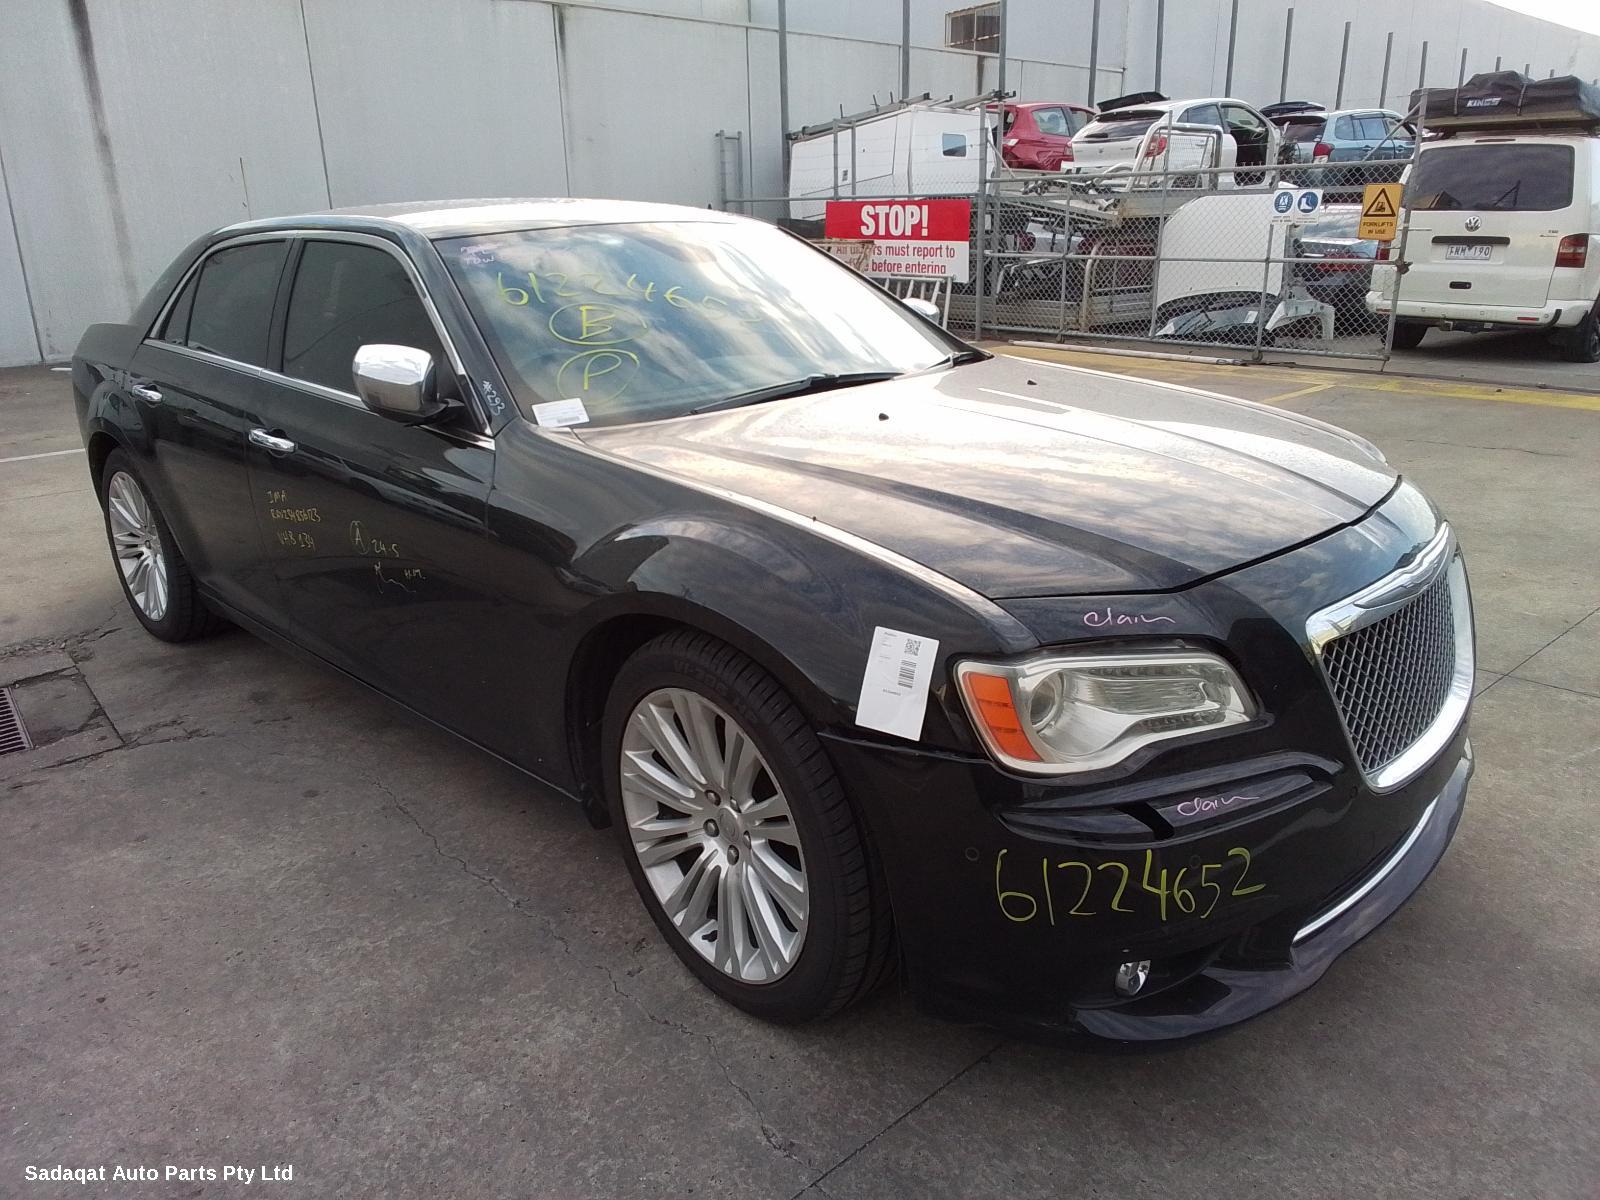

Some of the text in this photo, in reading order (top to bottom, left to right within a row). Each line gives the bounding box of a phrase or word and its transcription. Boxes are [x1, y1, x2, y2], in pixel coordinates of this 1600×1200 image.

[1466, 97, 1501, 107] KINGS
[860, 204, 929, 237] STOP!
[885, 244, 911, 257] must
[912, 244, 943, 261] report
[946, 244, 956, 258] to
[871, 258, 903, 273] before
[482, 379, 507, 417] #293
[995, 846, 1267, 927] 61224652
